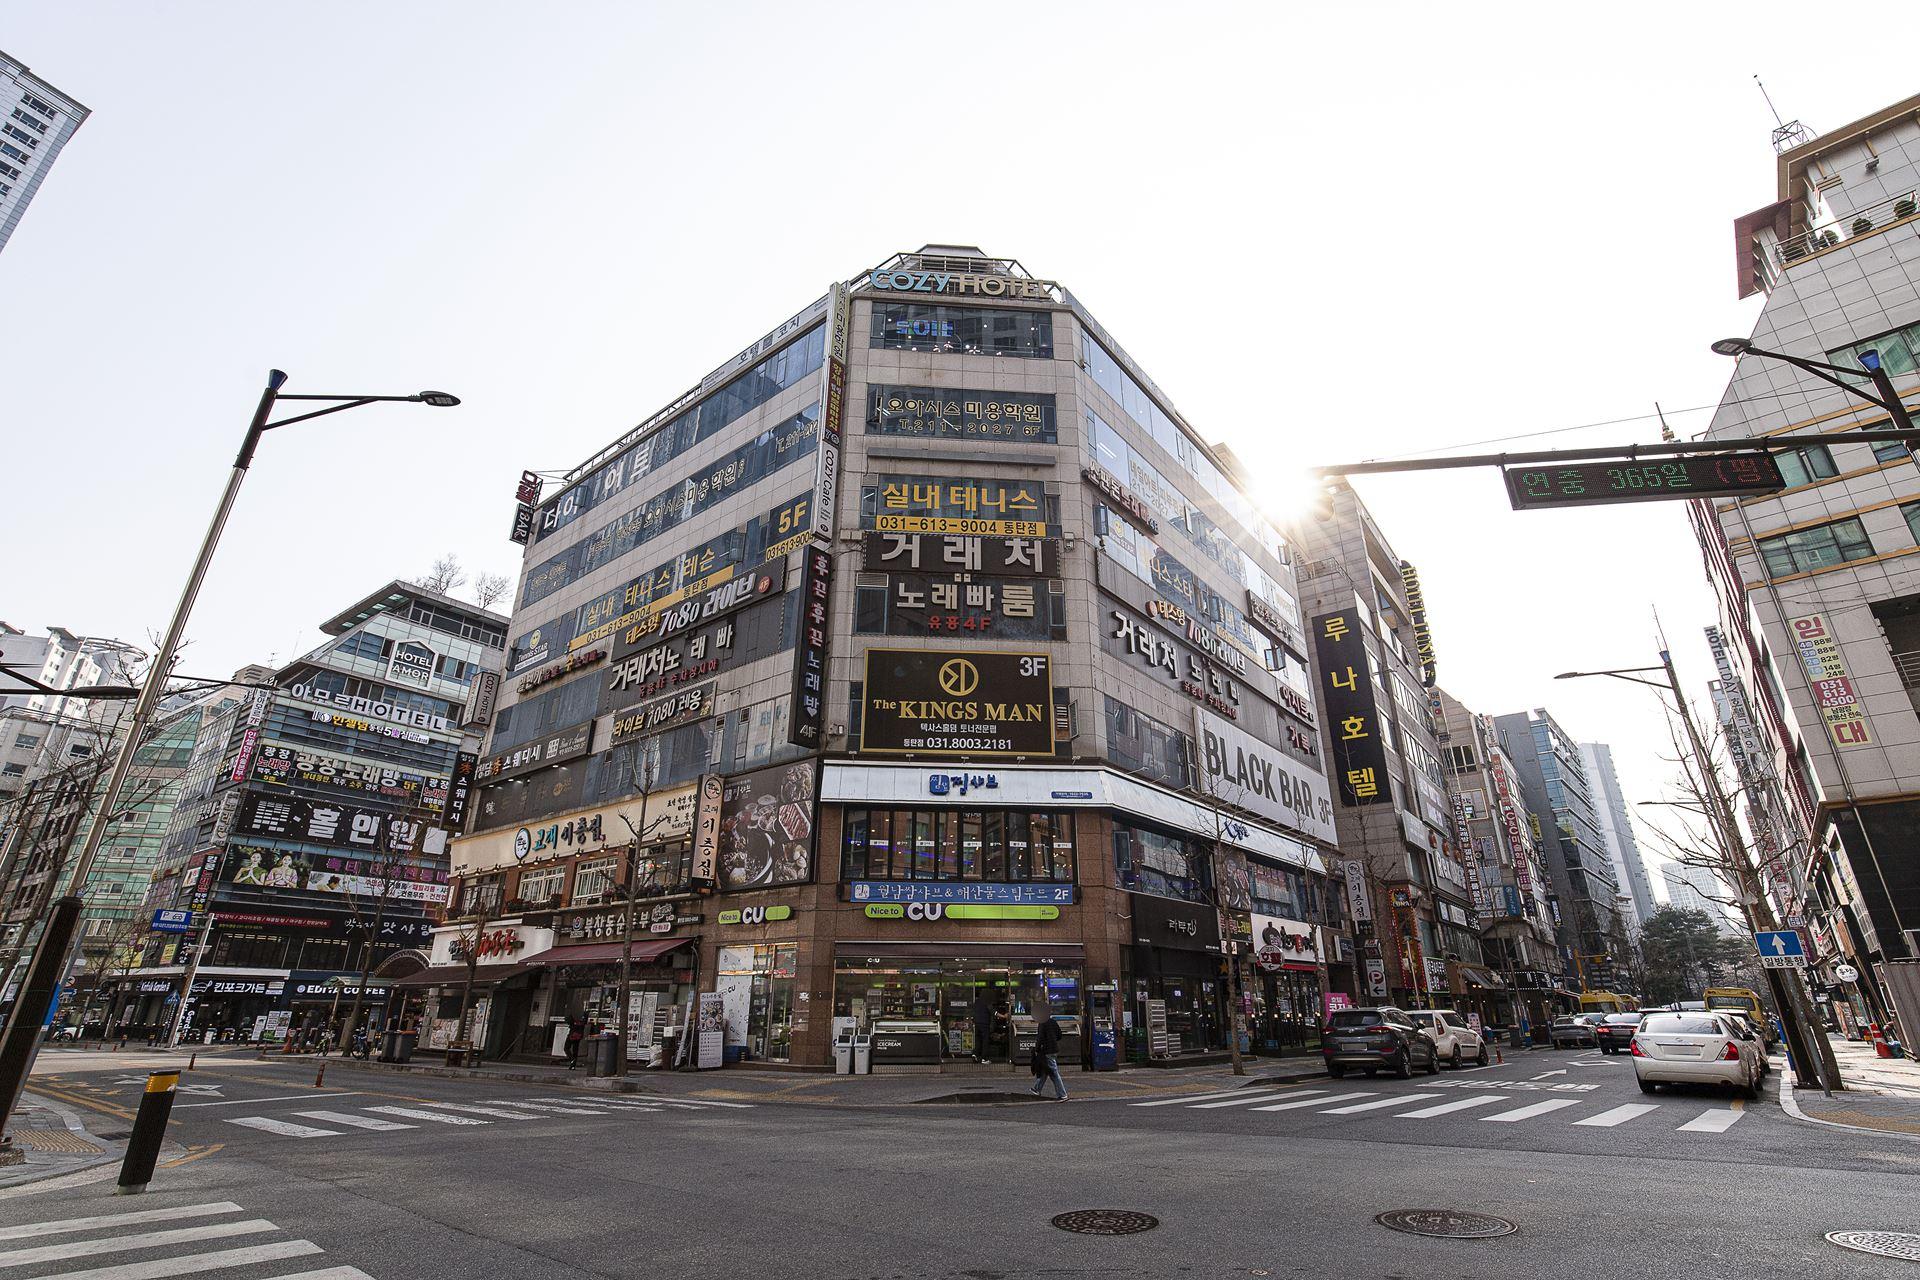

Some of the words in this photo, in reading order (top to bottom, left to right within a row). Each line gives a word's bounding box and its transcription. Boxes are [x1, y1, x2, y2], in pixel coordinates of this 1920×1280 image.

[869, 268, 951, 293] COZY
[958, 274, 1052, 300] HOTEL
[887, 397, 961, 421] 오아시스
[964, 400, 1042, 424] 미용학원
[823, 450, 835, 483] COZY
[1606, 463, 1692, 490] 365일
[883, 483, 940, 511] 실내
[950, 485, 1039, 513] 테니스
[777, 501, 807, 535] 5F
[880, 517, 997, 535] 031-613-9004
[1003, 520, 1038, 537] 동탄점
[880, 532, 1044, 573] 거래처
[624, 570, 671, 606] 테니스
[683, 547, 716, 578] 레슨
[658, 601, 700, 637] 7080
[1402, 565, 1424, 615] HOTEL
[1413, 620, 1436, 667] LUNA
[1113, 610, 1179, 679] 거래처
[1186, 615, 1216, 656] 7080
[1705, 626, 1725, 665] HOTEL
[396, 650, 432, 667] HOTEL
[608, 644, 667, 691] 거래처
[1019, 656, 1047, 677] 3F
[392, 664, 429, 681] AMOR
[484, 675, 495, 696] COZY
[1820, 679, 1843, 690] 031
[1822, 695, 1855, 707] 4500
[1823, 687, 1847, 698] 613
[291, 683, 351, 711] 아모르
[354, 699, 443, 731] HOTEL
[872, 699, 897, 710] The
[898, 700, 978, 721] KINGS
[984, 702, 1043, 723] MAN
[1324, 615, 1379, 798] 루나호텔
[612, 711, 646, 737] 라이브
[1833, 720, 1868, 744] 대
[264, 745, 291, 760] 광장
[926, 737, 1012, 750] 031.8003.2181
[257, 755, 292, 771] 노래방
[296, 752, 338, 776] 광장
[342, 760, 401, 787] 노래방
[403, 780, 418, 791] 5F
[1204, 728, 1278, 803] BLACK
[1278, 767, 1316, 820] BAR
[1318, 796, 1331, 826] 3F
[531, 824, 559, 851] 고래
[699, 817, 716, 878] 이층집
[1054, 887, 1069, 901] 2F
[1352, 881, 1368, 920] 이층집
[742, 906, 765, 924] CU
[870, 906, 890, 915] Nice
[890, 907, 899, 915] to
[907, 902, 942, 921] CU
[1764, 956, 1805, 967] 일방통행
[214, 982, 266, 994] 킨포크가든
[343, 987, 386, 995] COFEE
